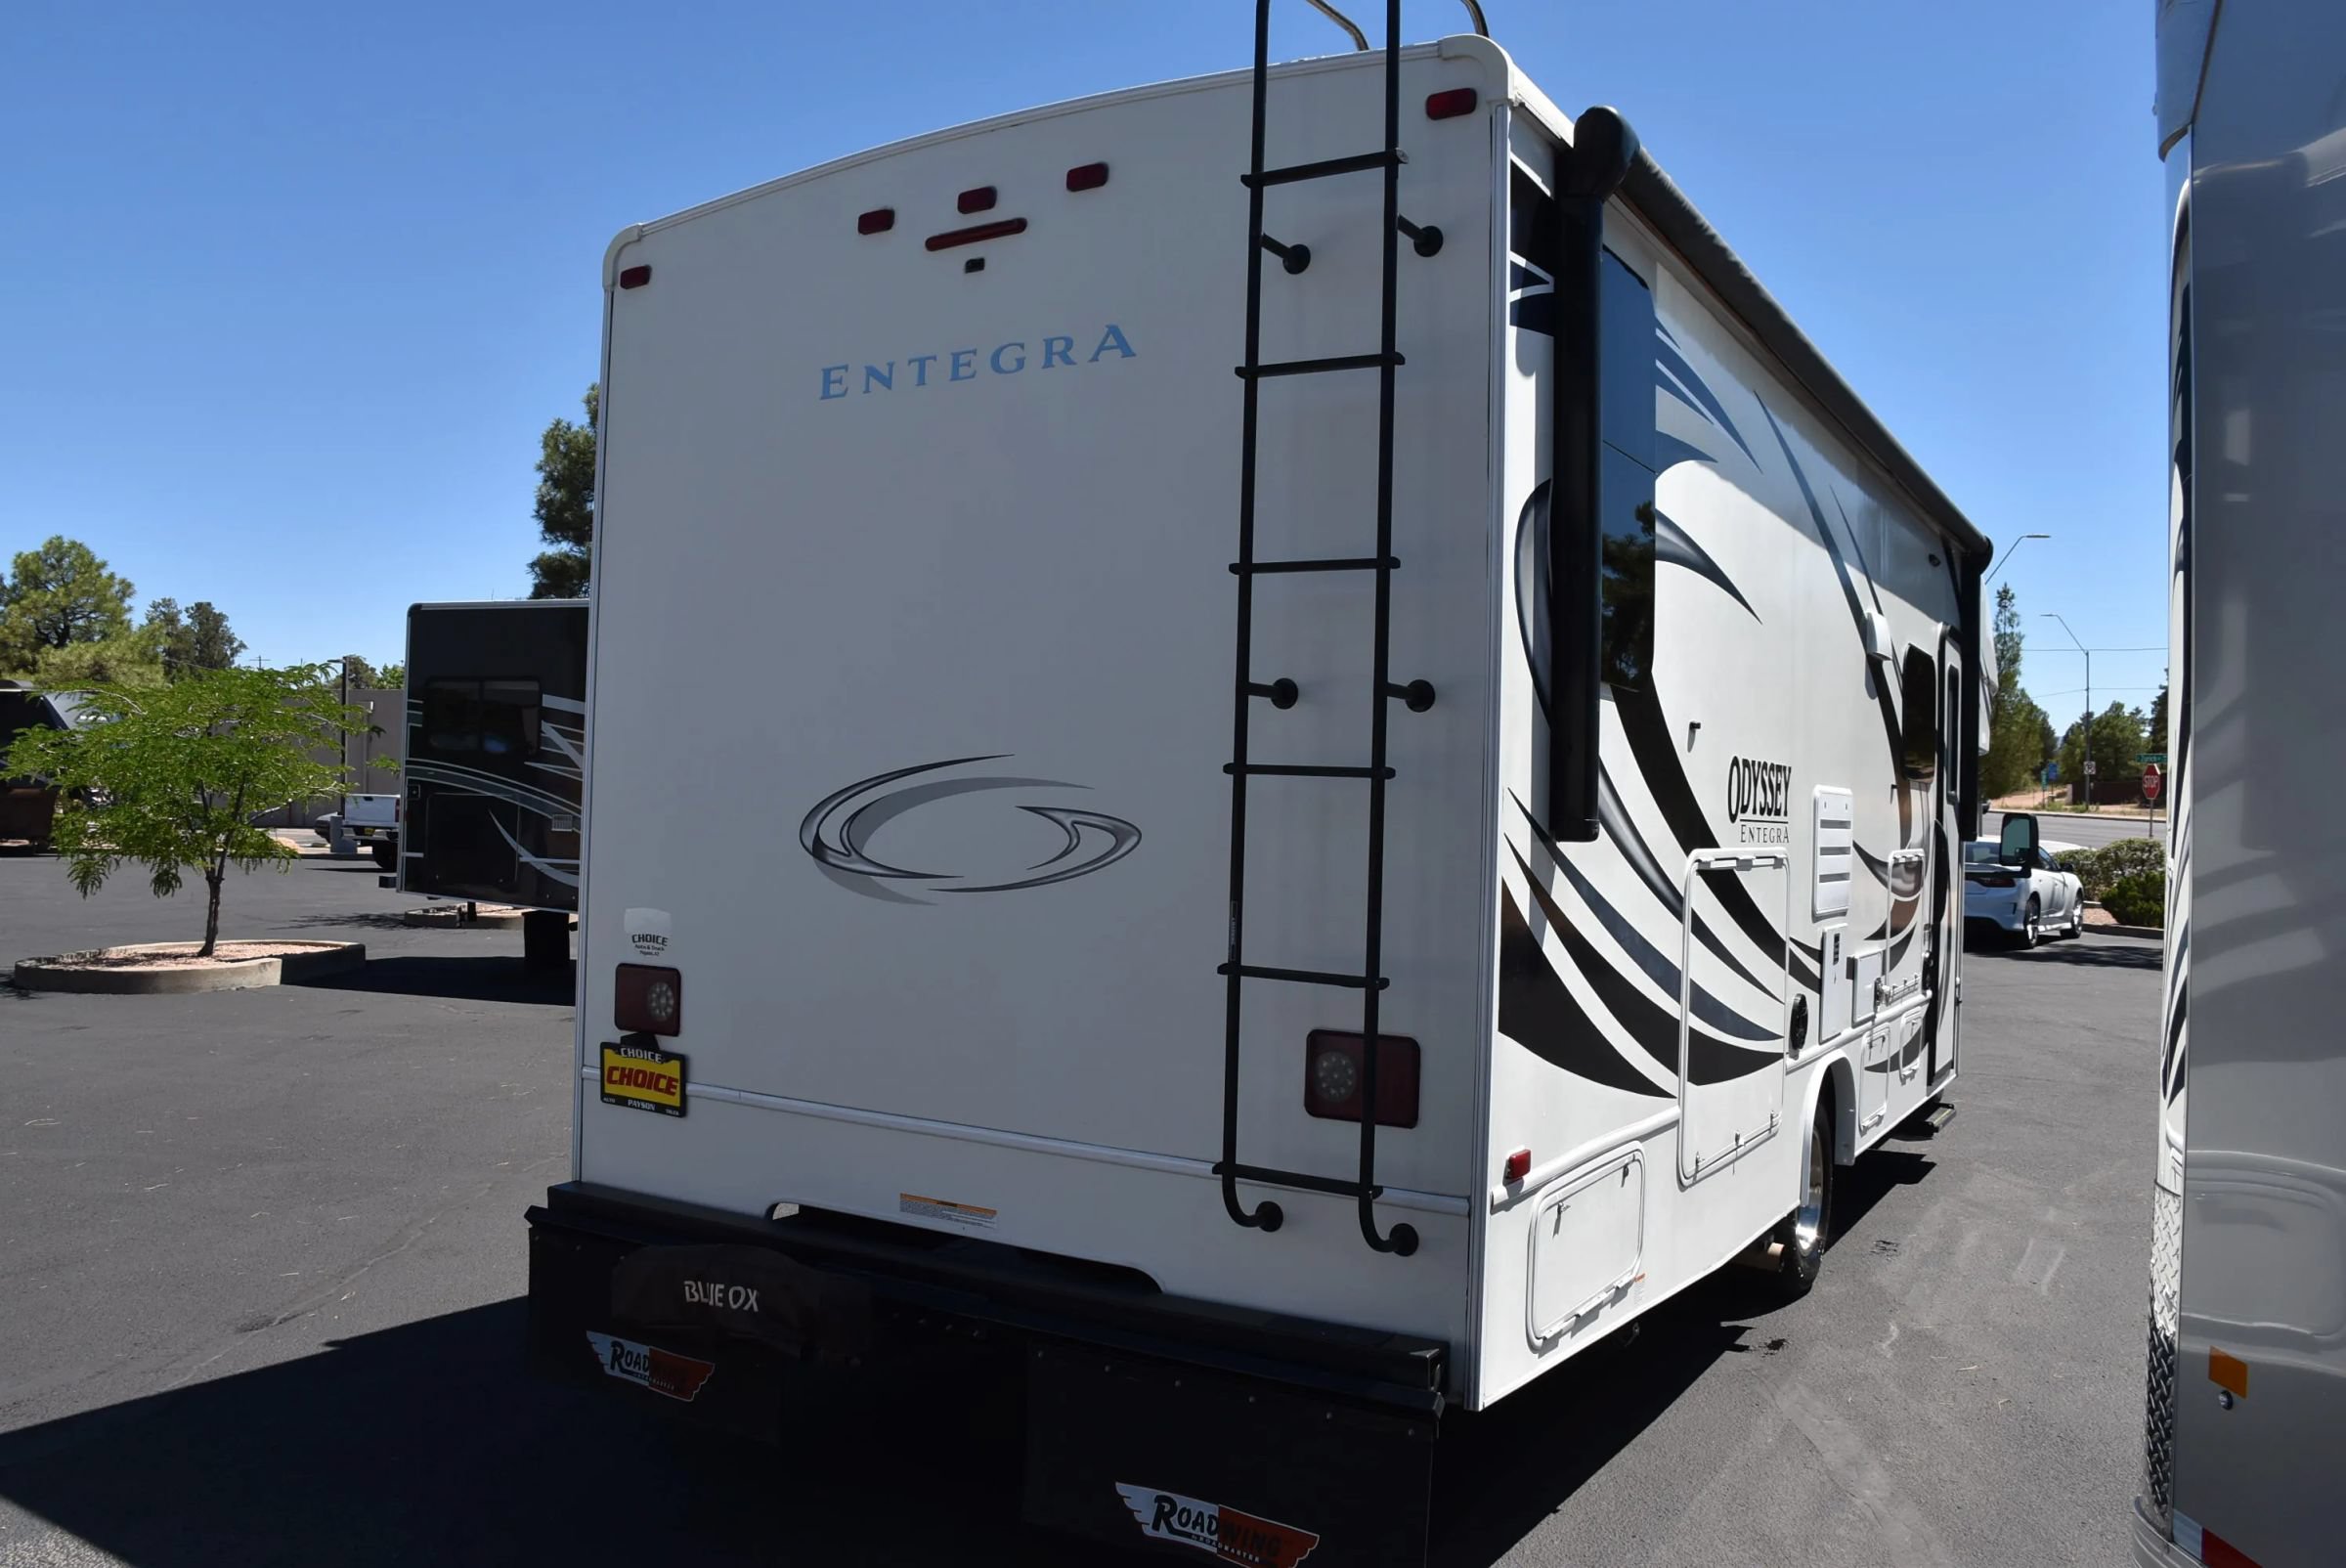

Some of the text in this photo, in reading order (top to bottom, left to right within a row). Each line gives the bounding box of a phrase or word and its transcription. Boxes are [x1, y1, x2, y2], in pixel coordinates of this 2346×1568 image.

[819, 324, 1136, 400] ENTEGRA
[1727, 756, 1792, 824] ODYSSEY
[2144, 775, 2158, 788] STOP
[1740, 824, 1790, 844] ENTEGRA
[631, 934, 669, 947] CHOICE
[620, 1047, 663, 1064] CHOICE
[606, 1066, 679, 1097] CHOICE
[628, 1099, 656, 1111] PAYSON
[684, 1280, 760, 1312] BLUE OX
